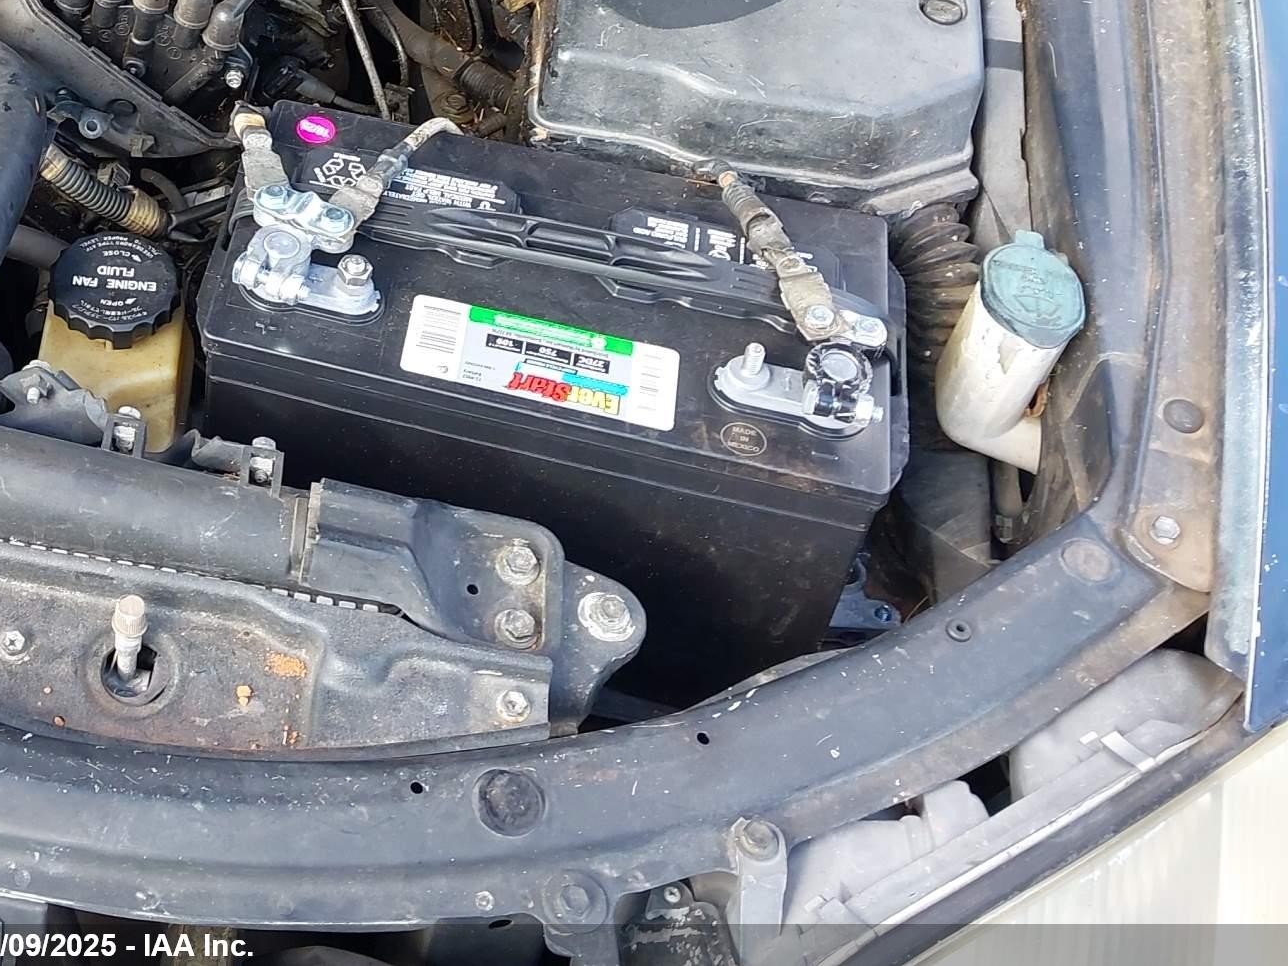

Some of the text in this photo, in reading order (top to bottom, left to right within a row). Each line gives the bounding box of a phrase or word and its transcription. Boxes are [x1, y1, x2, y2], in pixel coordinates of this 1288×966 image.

[96, 265, 135, 277] FLUID
[72, 275, 157, 292] ENGINE FAN
[100, 298, 124, 307] OPEN
[496, 338, 514, 347] 109
[539, 347, 558, 357] 750
[578, 356, 605, 368] 27DC
[507, 372, 621, 415] EverStart
[732, 426, 757, 436] MADE
